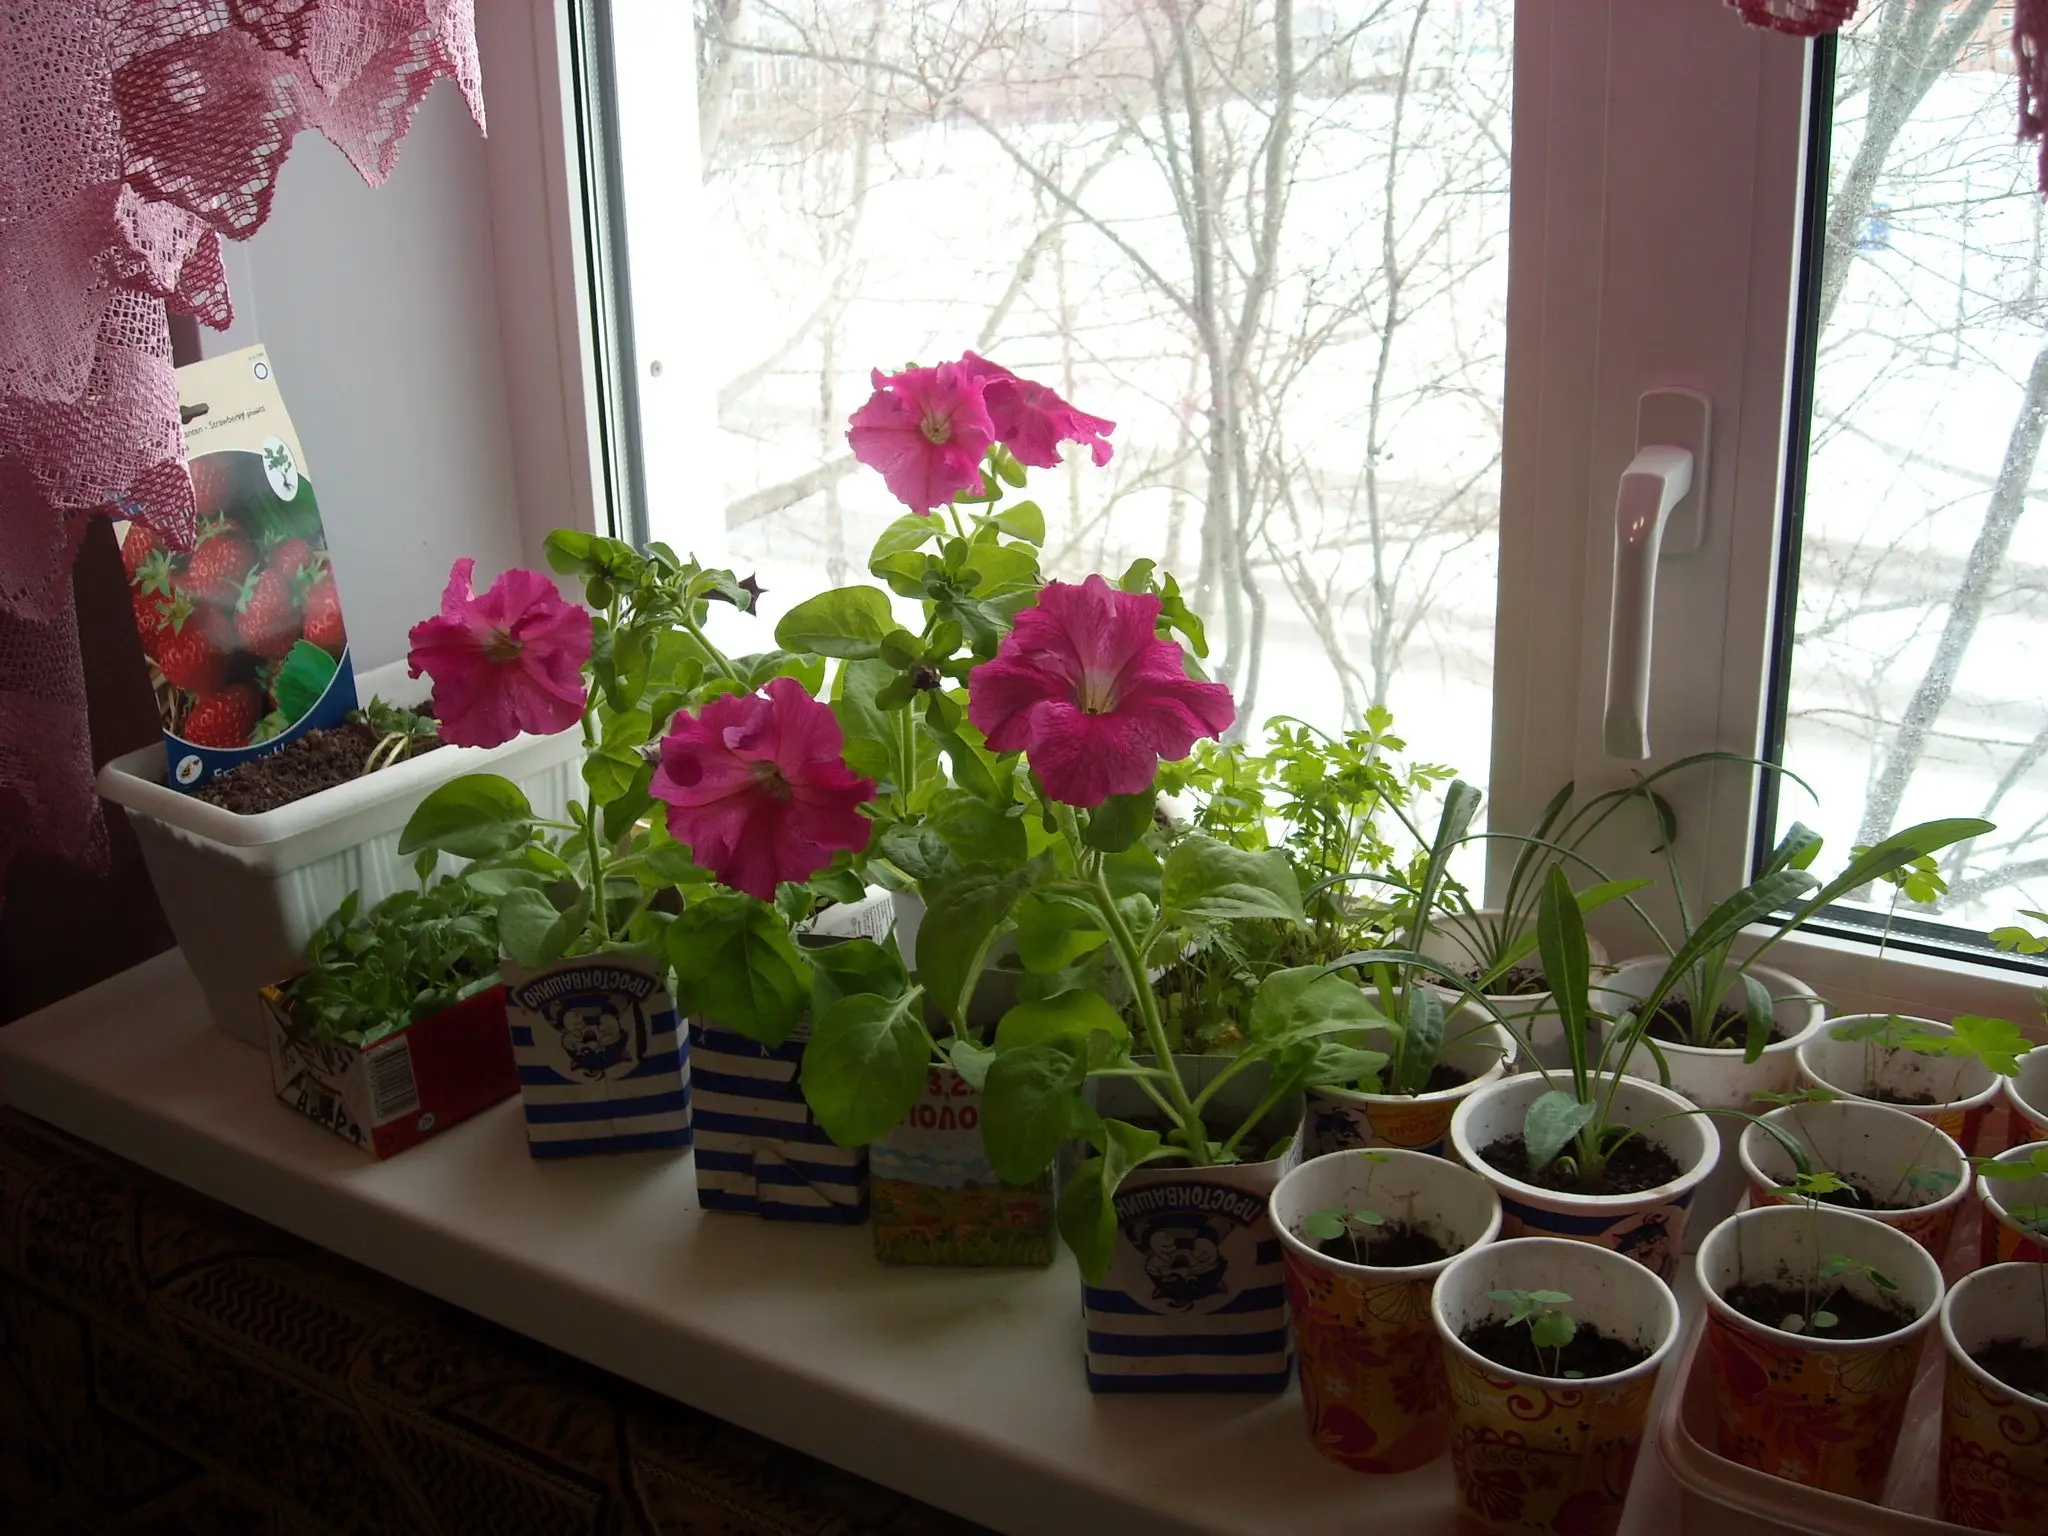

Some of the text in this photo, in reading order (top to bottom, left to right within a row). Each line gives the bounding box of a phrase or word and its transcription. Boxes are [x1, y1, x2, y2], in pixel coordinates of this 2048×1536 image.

[208, 412, 245, 430] Strawberry
[522, 969, 652, 1007] ПРОСТОКВАШИНО
[928, 1070, 977, 1101] 3,2
[1116, 1186, 1262, 1222] ПРОСТОКВАШИН
